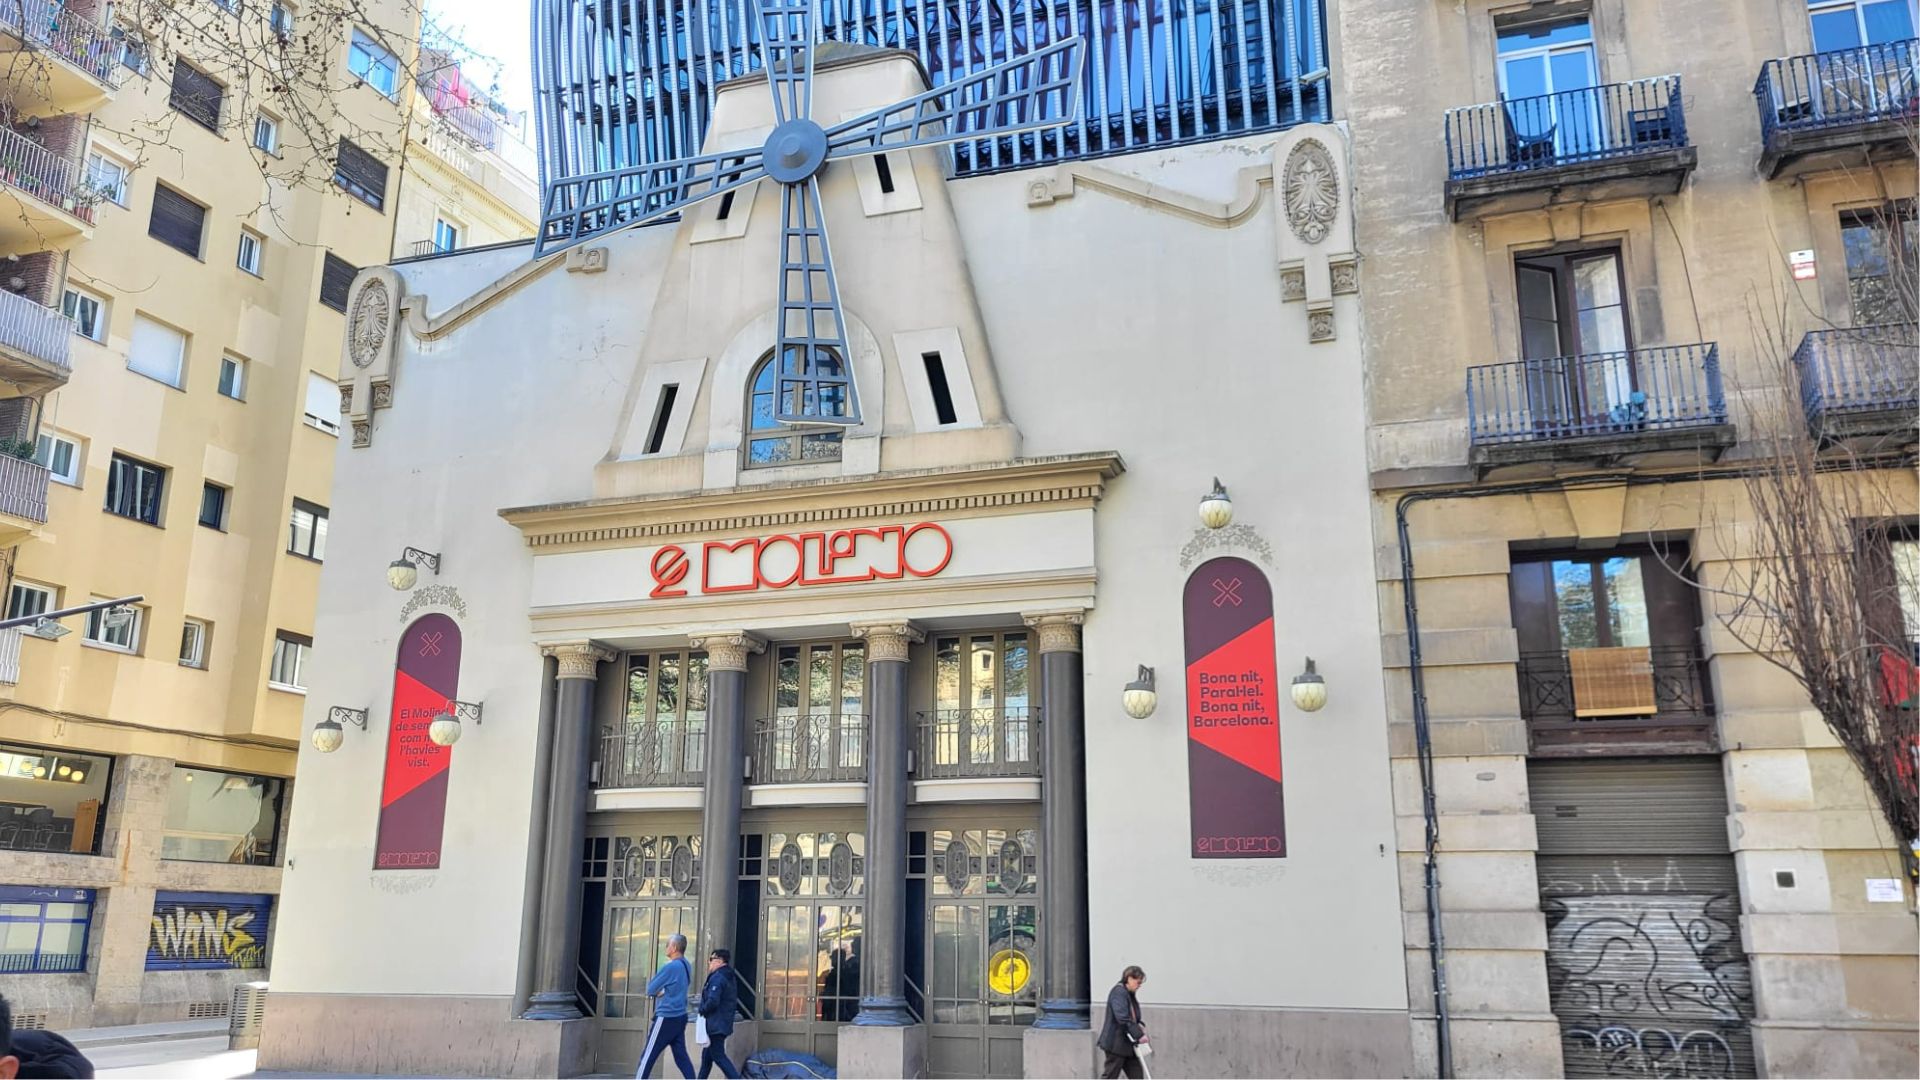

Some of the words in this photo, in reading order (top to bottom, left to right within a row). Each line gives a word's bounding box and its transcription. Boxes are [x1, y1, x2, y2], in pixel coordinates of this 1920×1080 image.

[1199, 672, 1237, 684] Bona
[1241, 670, 1264, 684] nit,
[1200, 701, 1238, 712] Bona
[1242, 699, 1265, 713] nit,
[400, 708, 410, 719] El
[395, 721, 408, 731] de
[1194, 714, 1274, 727] Barcelona.
[399, 735, 422, 743] com
[407, 757, 430, 767] vist.
